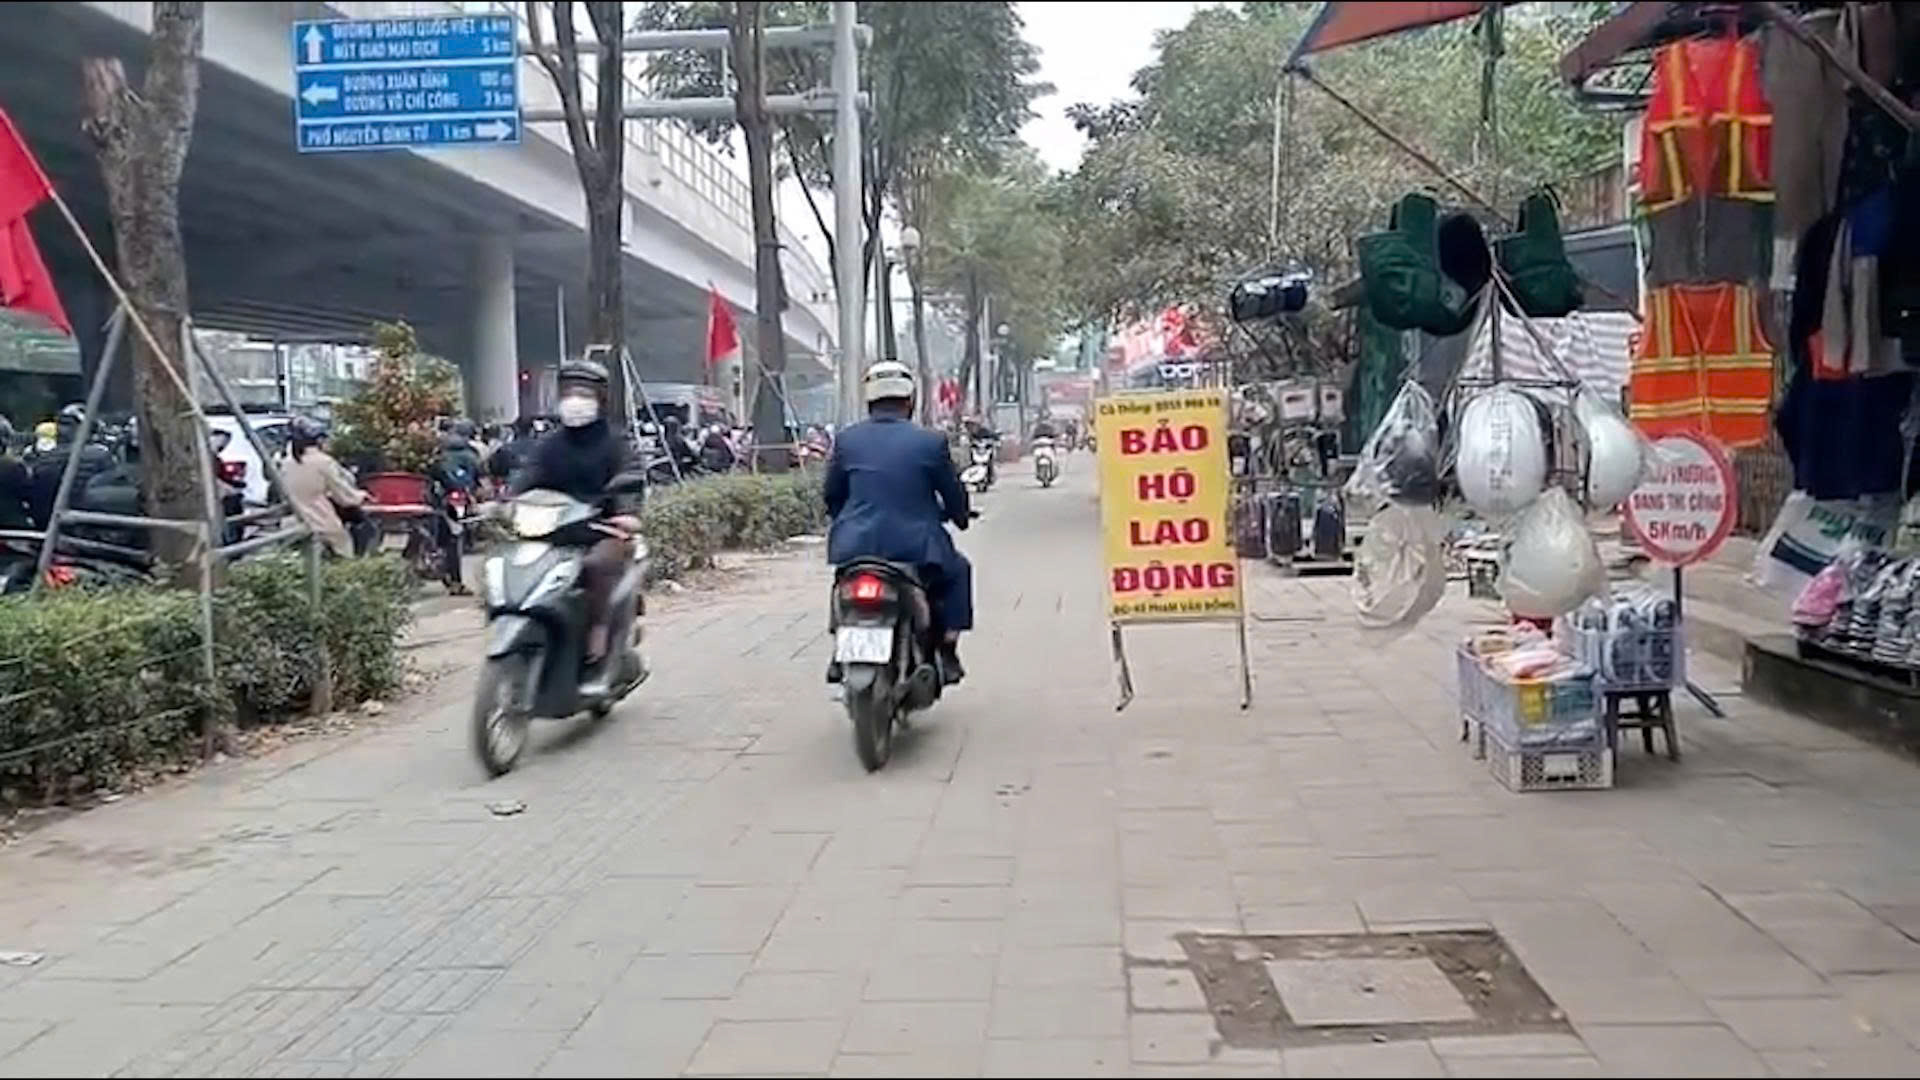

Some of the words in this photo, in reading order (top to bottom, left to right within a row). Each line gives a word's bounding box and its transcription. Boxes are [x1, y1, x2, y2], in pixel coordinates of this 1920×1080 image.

[1120, 418, 1209, 455] BẢO
[1138, 467, 1195, 504] HỘ
[1130, 518, 1209, 546] LAO
[1112, 560, 1235, 597] ĐỘNG
